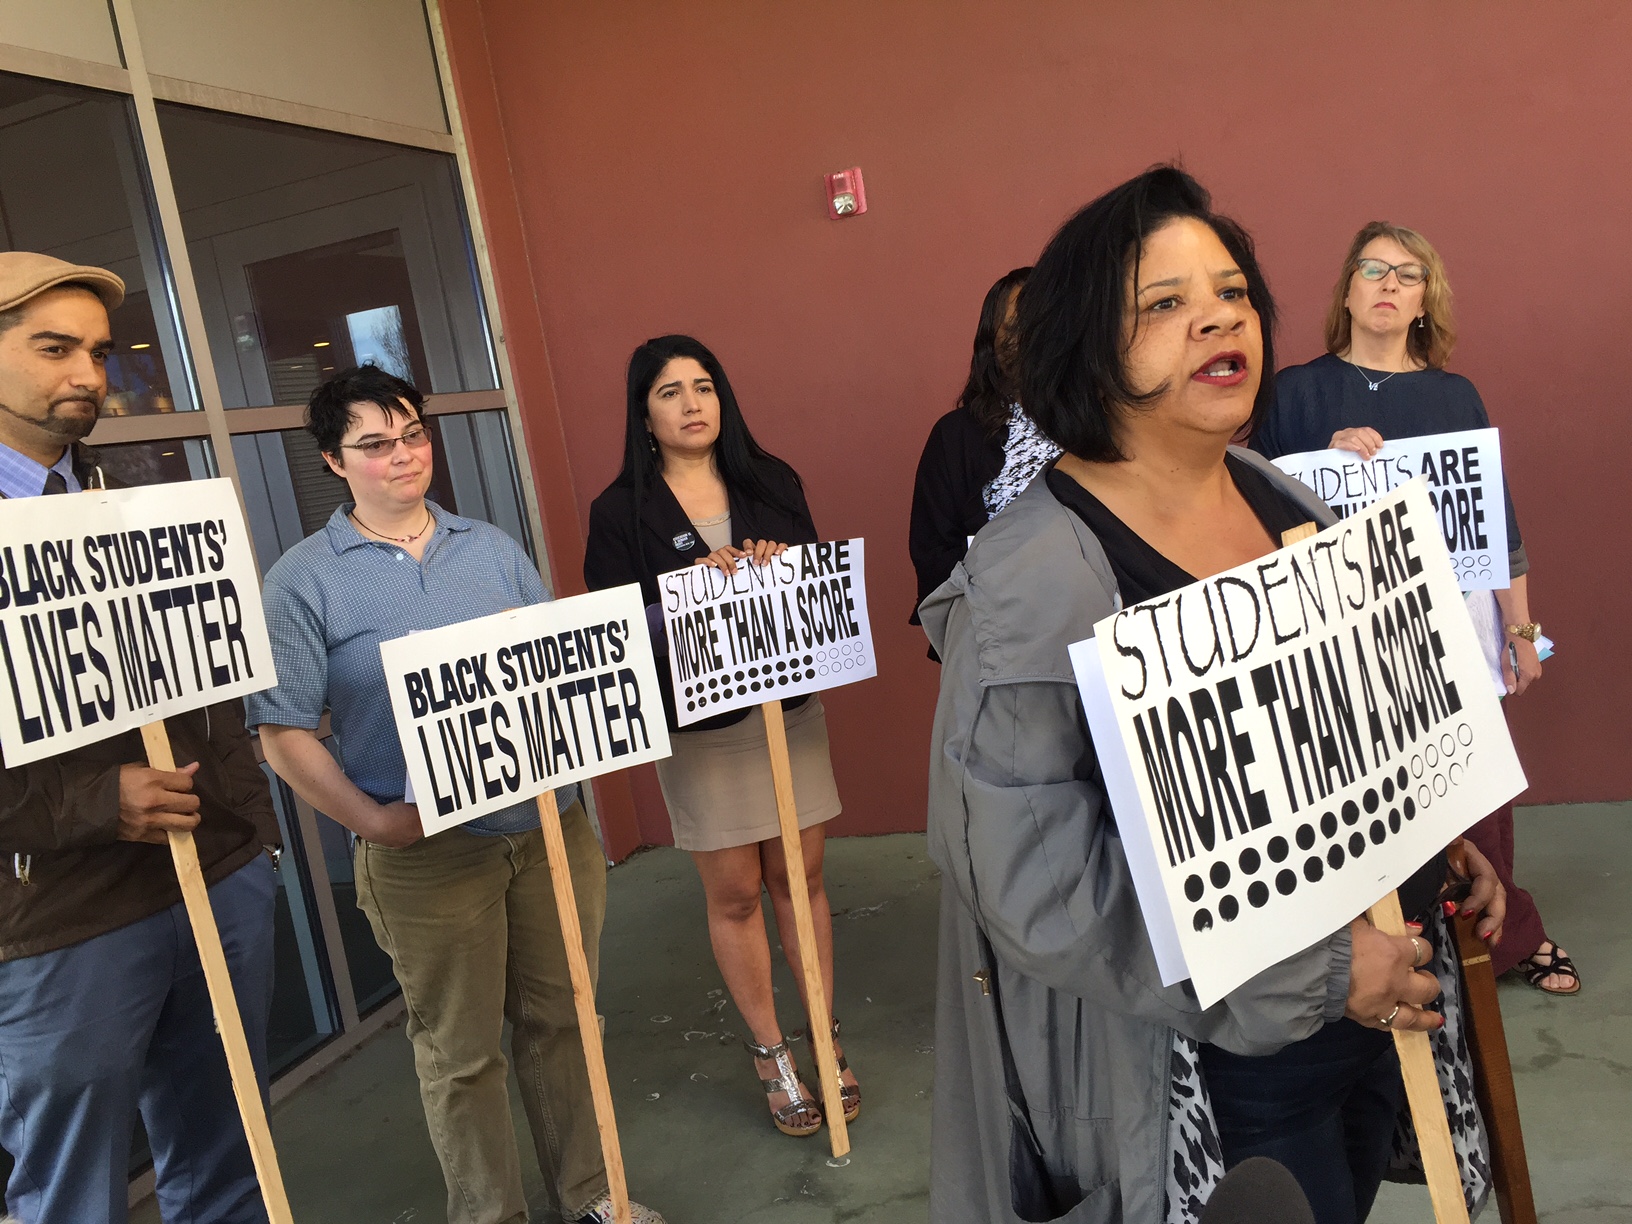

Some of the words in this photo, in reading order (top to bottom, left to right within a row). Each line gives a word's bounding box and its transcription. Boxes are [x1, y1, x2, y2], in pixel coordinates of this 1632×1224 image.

[1286, 455, 1412, 501] DENTS
[1421, 446, 1482, 487] ARE
[1429, 486, 1489, 553] ORE
[83, 519, 227, 592] STUDENTS'
[666, 548, 795, 613] STUDENTS
[800, 540, 850, 581] ARE
[1113, 529, 1366, 700] STUDENTS
[1365, 500, 1424, 601] ARE
[0, 601, 116, 744] LIVES
[107, 578, 254, 712] MATTER
[404, 653, 497, 719] BLACK
[497, 619, 628, 692] STUDENTS'
[671, 606, 724, 683] MORE
[719, 593, 780, 666] THAN
[781, 590, 799, 653] A
[796, 575, 860, 649] SCORE
[417, 700, 521, 817] LIVES
[517, 667, 651, 783] MATTER
[1132, 676, 1272, 867] MORE
[1250, 635, 1368, 814] THAN
[1351, 625, 1391, 770] A
[1371, 582, 1463, 753] SCORE
